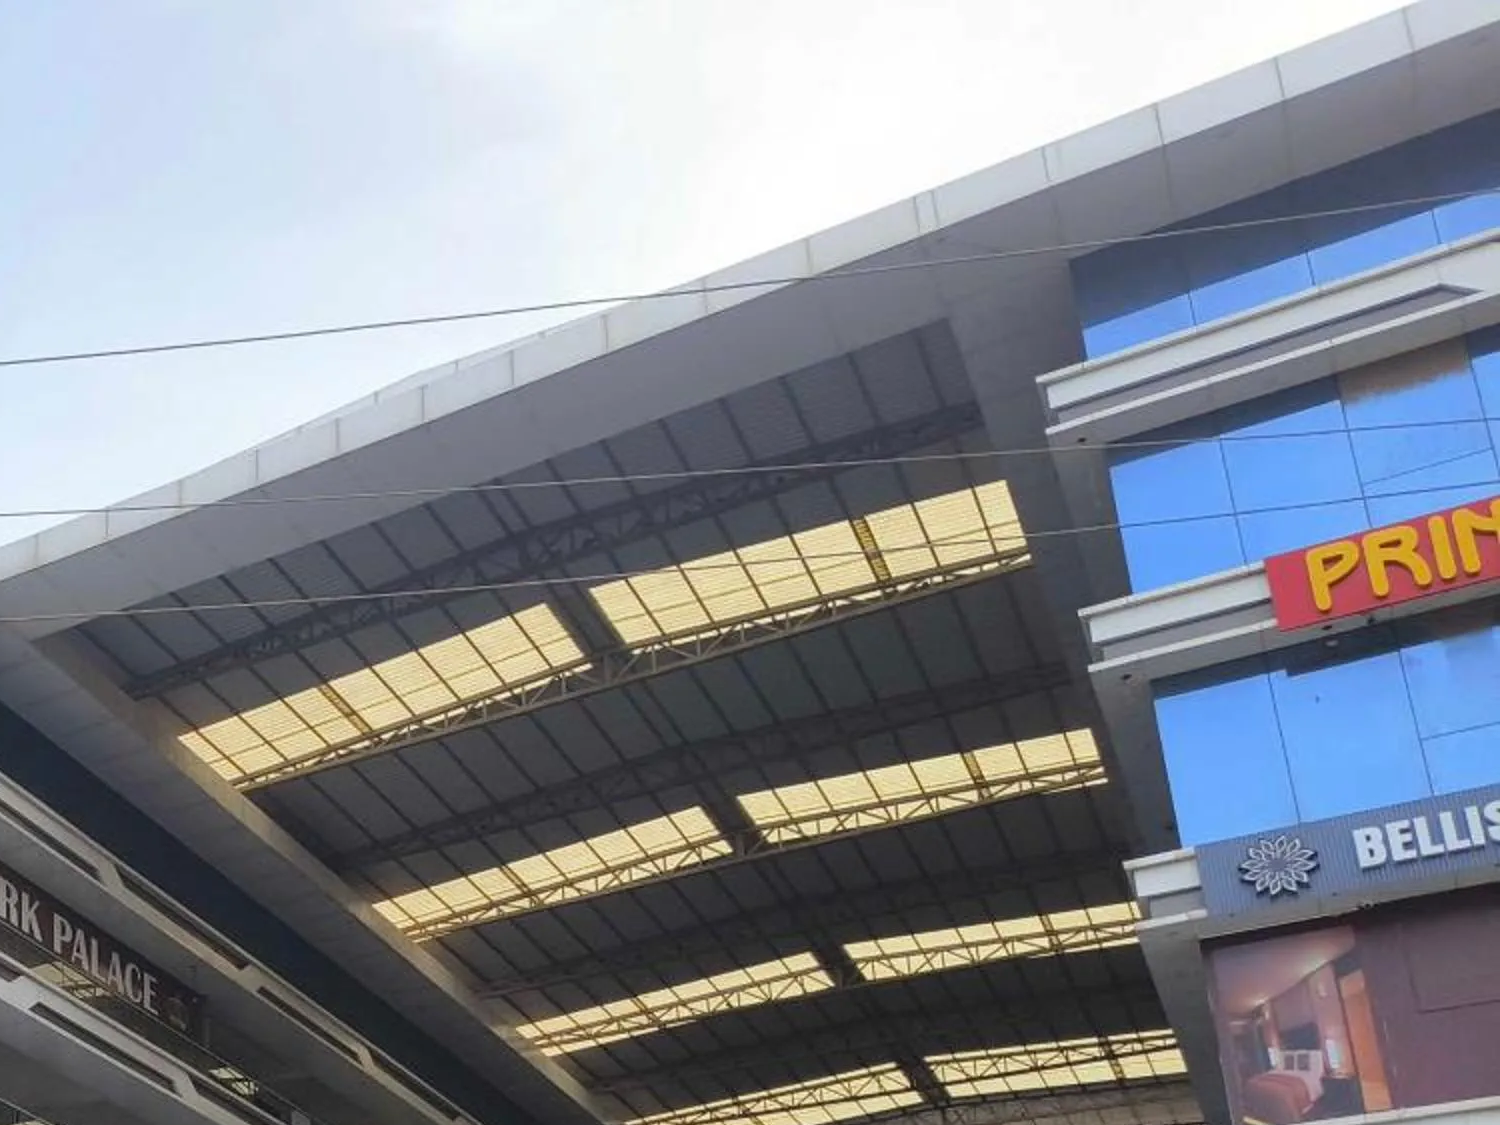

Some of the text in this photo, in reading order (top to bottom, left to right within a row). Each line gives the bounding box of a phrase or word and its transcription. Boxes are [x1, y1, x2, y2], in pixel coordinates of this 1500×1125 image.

[1305, 499, 1500, 612] PRIN
[1352, 799, 1500, 870] BELLIS
[52, 911, 161, 1017] PALACE
